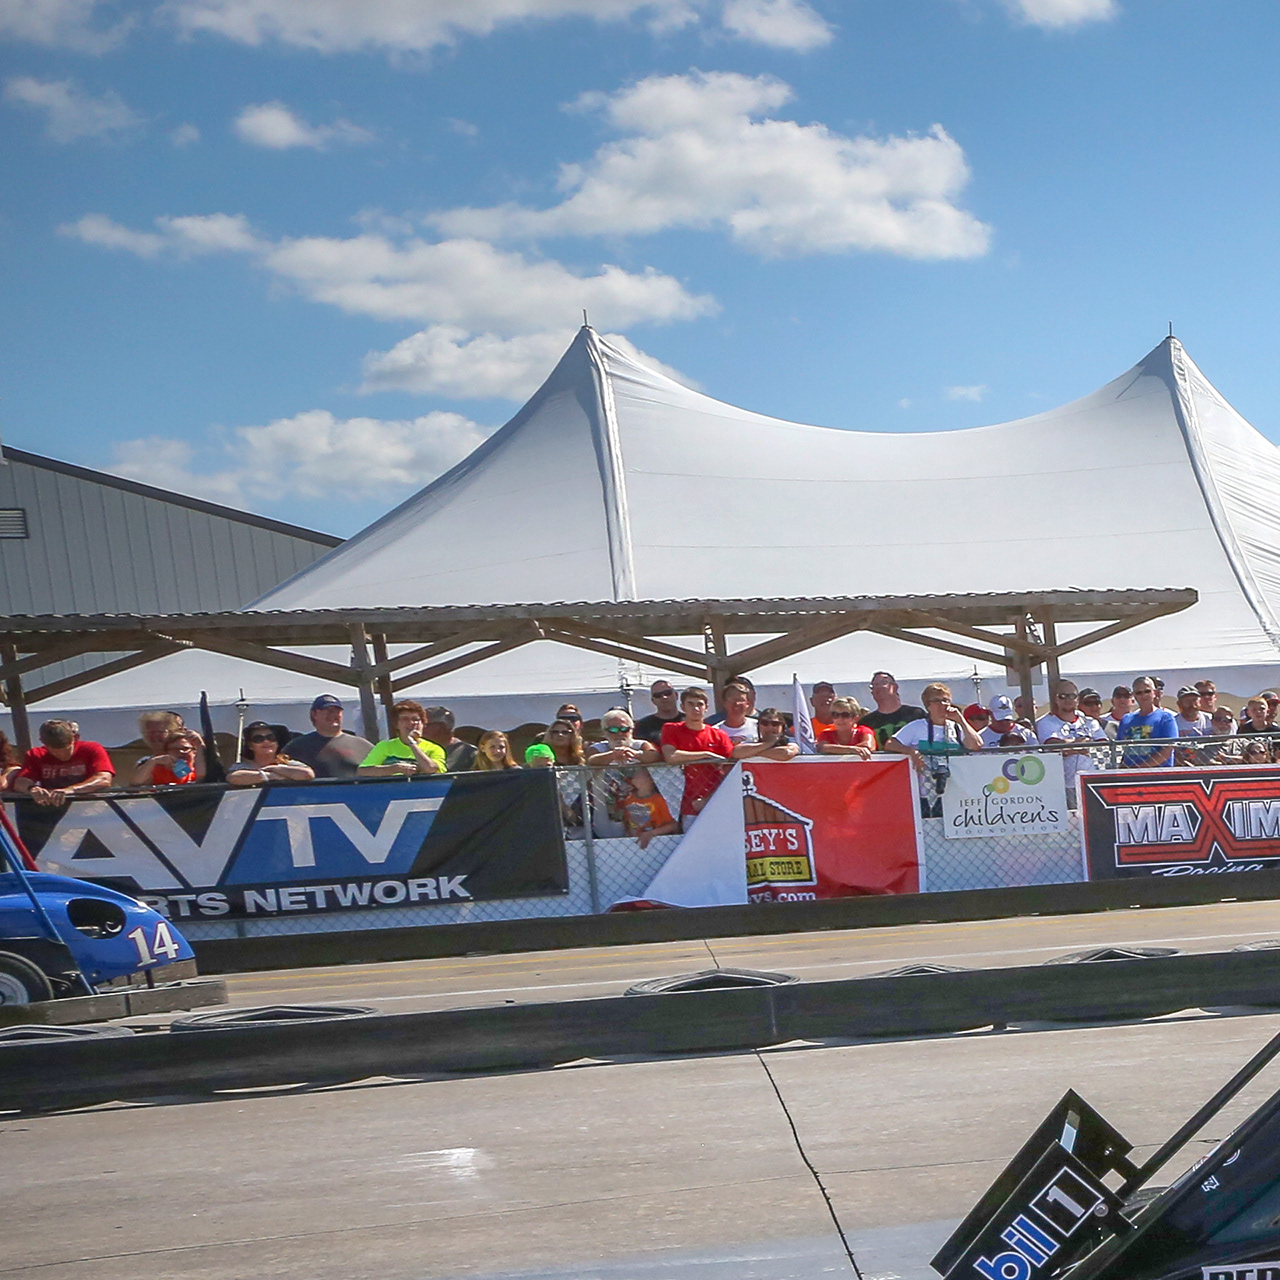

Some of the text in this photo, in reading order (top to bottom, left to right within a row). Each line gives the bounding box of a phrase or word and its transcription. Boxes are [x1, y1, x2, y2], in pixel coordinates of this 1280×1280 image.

[953, 786, 1059, 828] children's
[960, 796, 1043, 808] JEFF GORDON
[30, 789, 446, 890] AVTV
[955, 825, 1059, 836] FOUNDATION
[769, 861, 803, 876] STORE
[147, 874, 472, 917] RTS NETWORK
[128, 920, 180, 968] 14
